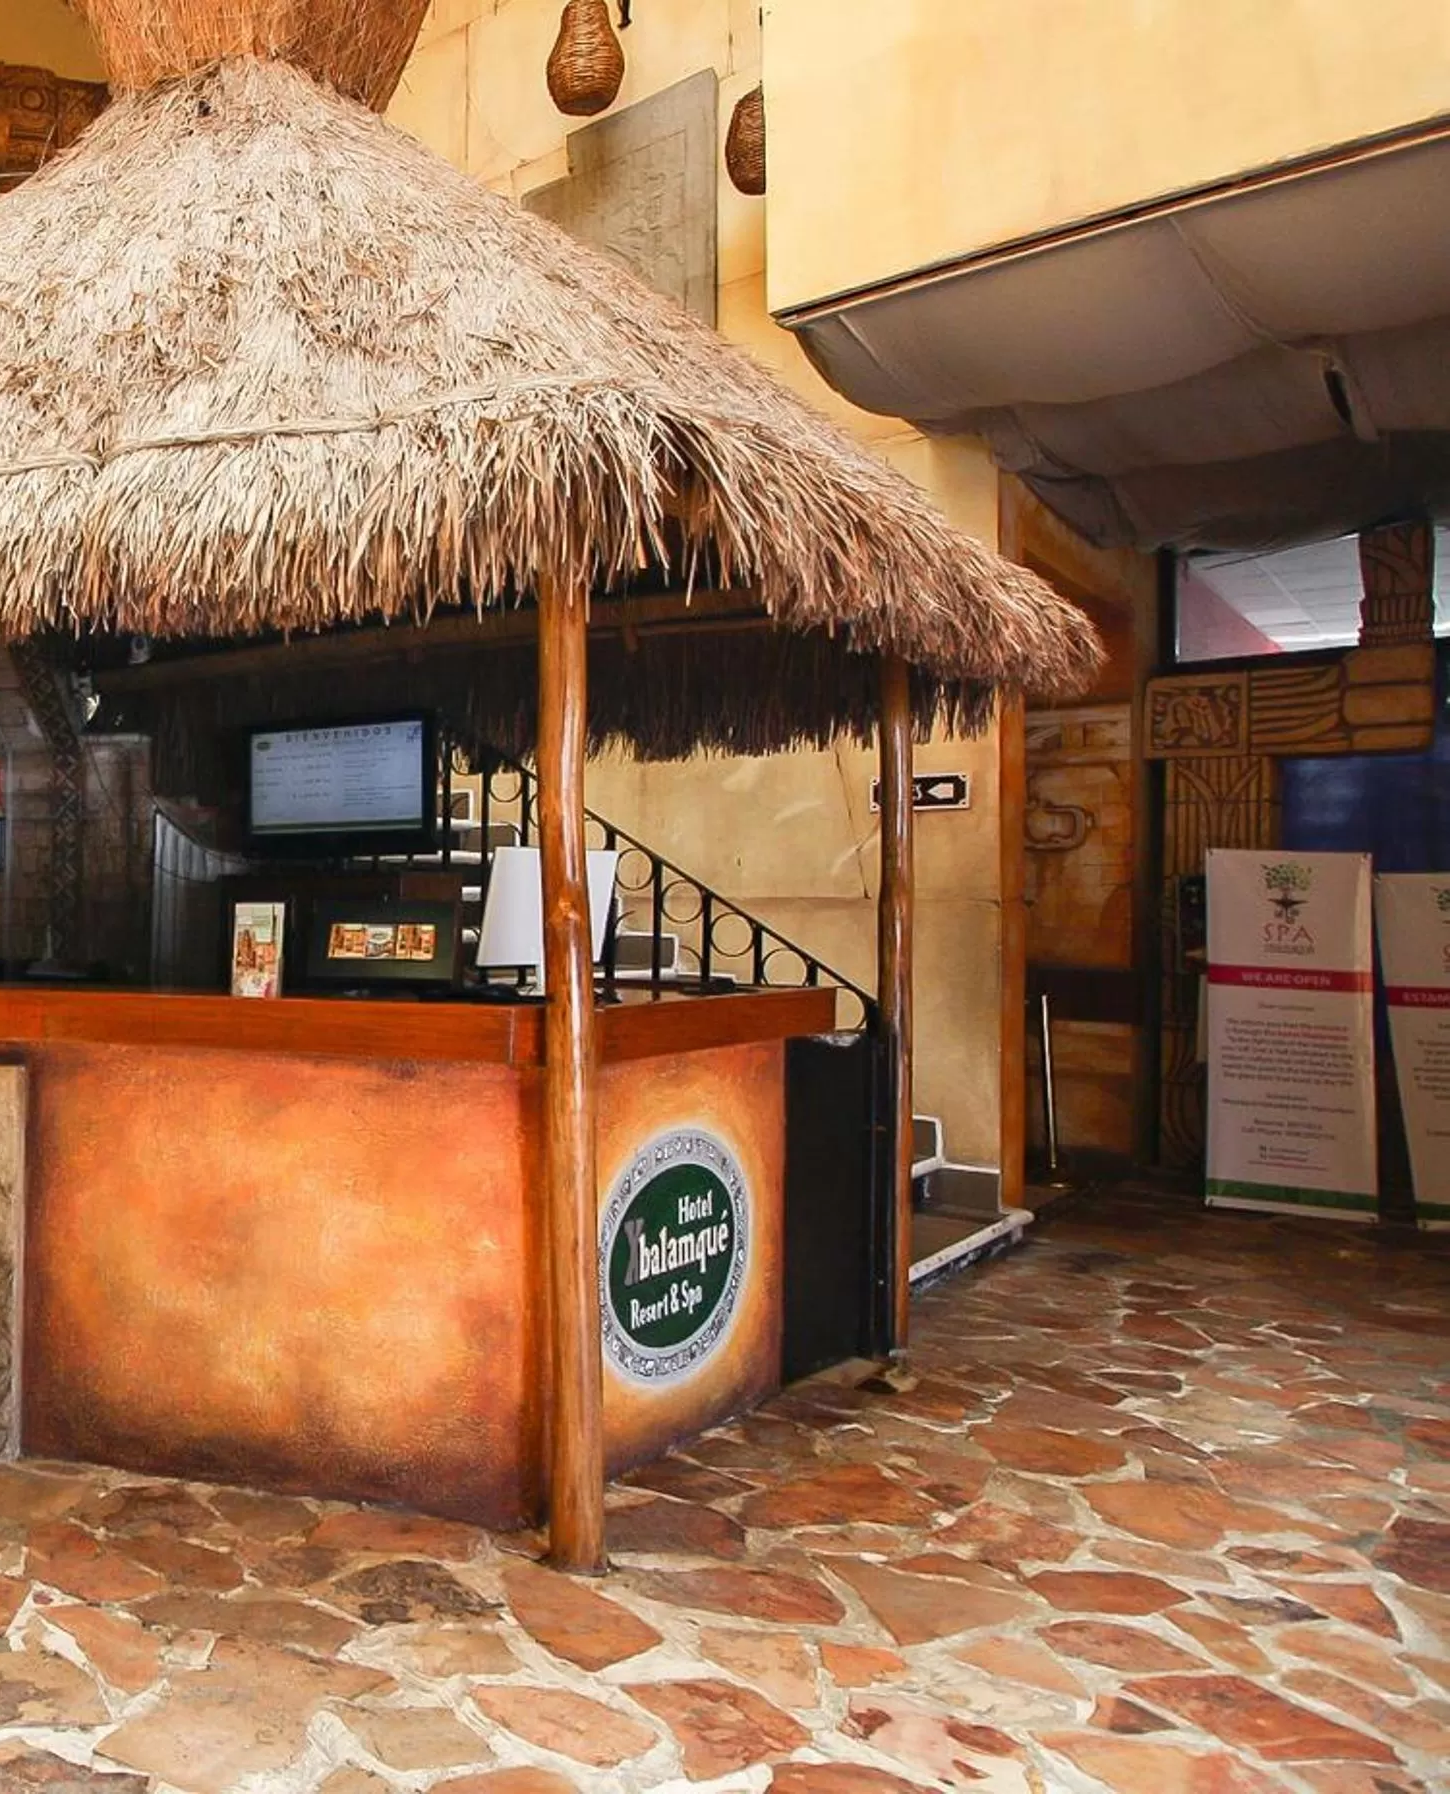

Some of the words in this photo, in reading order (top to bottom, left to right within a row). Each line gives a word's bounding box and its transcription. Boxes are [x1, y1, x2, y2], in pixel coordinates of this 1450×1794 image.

[1261, 923, 1315, 944] SPA
[1265, 973, 1291, 984] ARE
[1294, 974, 1332, 986] OPEN
[677, 1189, 713, 1225] Hotel
[630, 1294, 669, 1330] Resort
[670, 1283, 680, 1313] &
[680, 1279, 703, 1315] Spa
